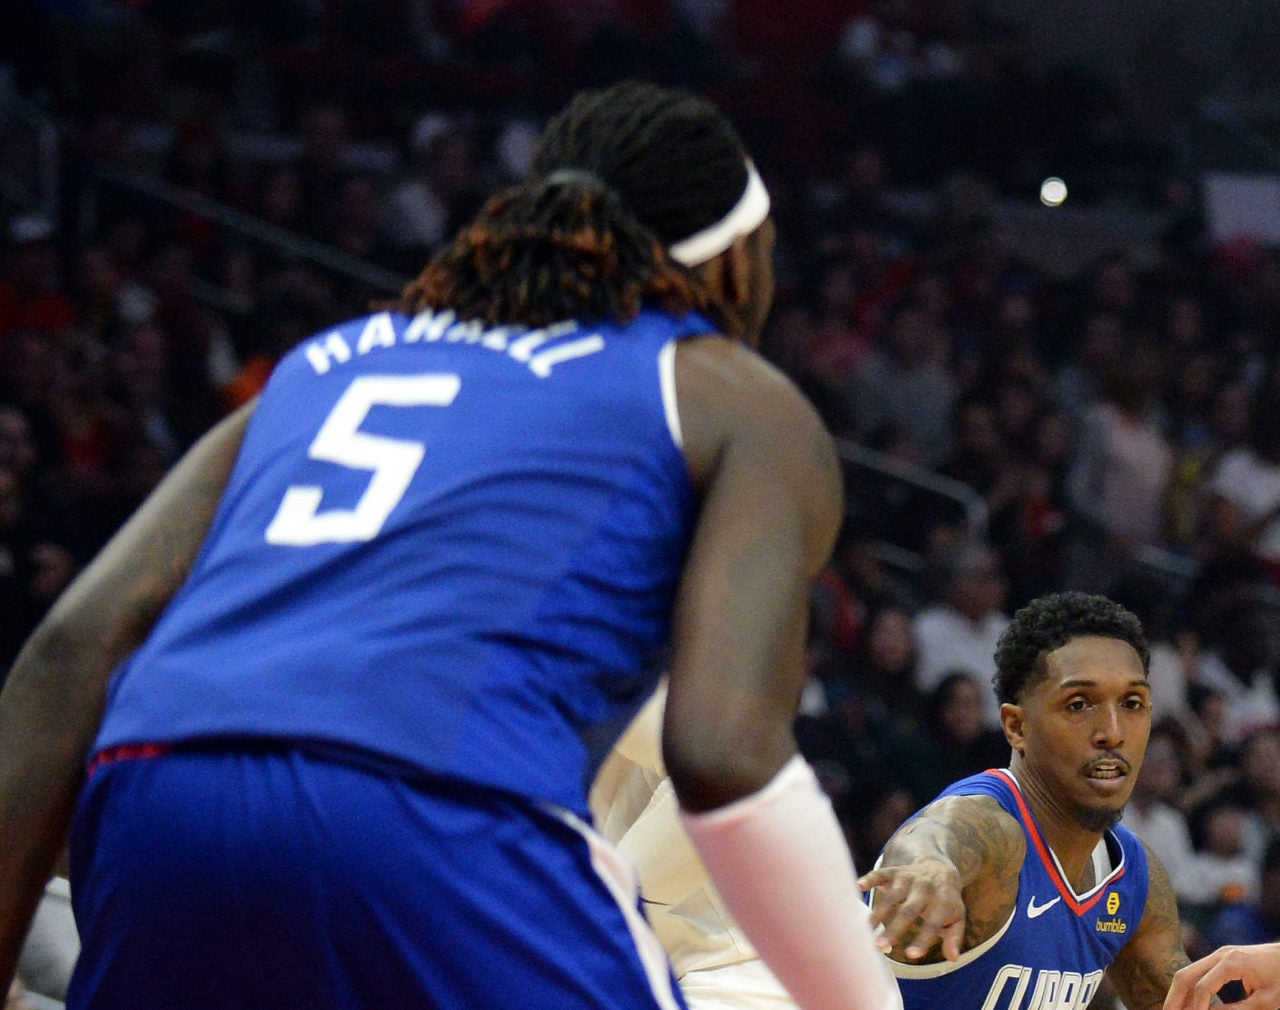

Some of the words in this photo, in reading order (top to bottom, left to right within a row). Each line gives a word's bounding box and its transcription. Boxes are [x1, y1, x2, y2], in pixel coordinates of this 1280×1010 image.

[305, 307, 604, 378] HALL
[266, 373, 462, 547] 5
[1096, 917, 1127, 934] bumble
